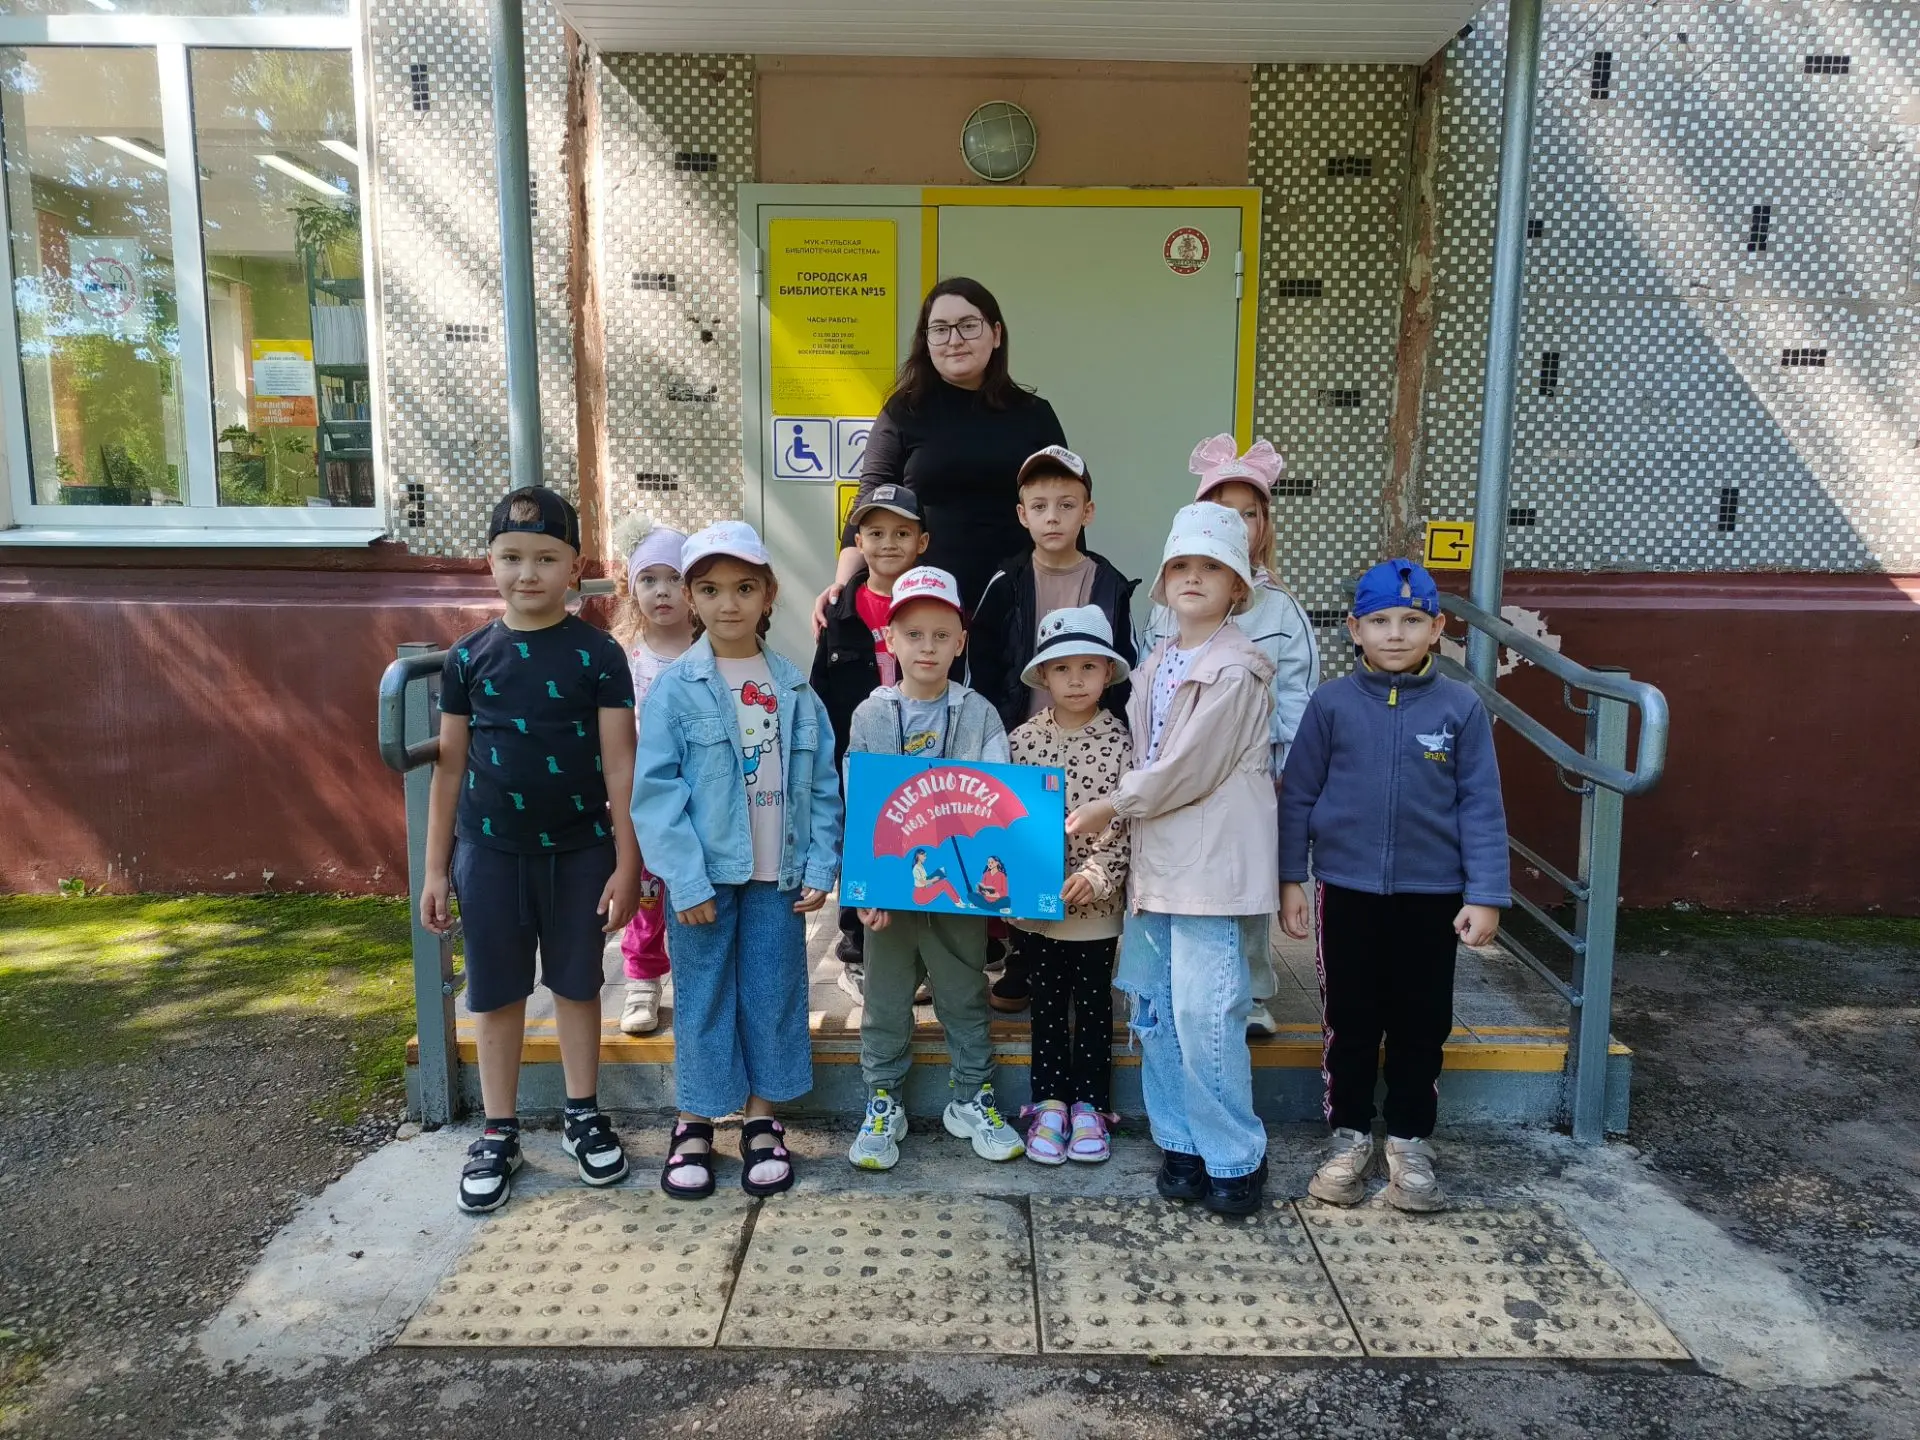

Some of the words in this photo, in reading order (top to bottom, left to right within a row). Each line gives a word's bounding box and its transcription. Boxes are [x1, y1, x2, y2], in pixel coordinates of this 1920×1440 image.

[797, 272, 868, 283] ГОРОДСКАЯ
[779, 285, 858, 296] БИБЛИОТЕКА
[860, 286, 886, 297] №15
[886, 772, 1000, 824] БИБЛИОТЕКА
